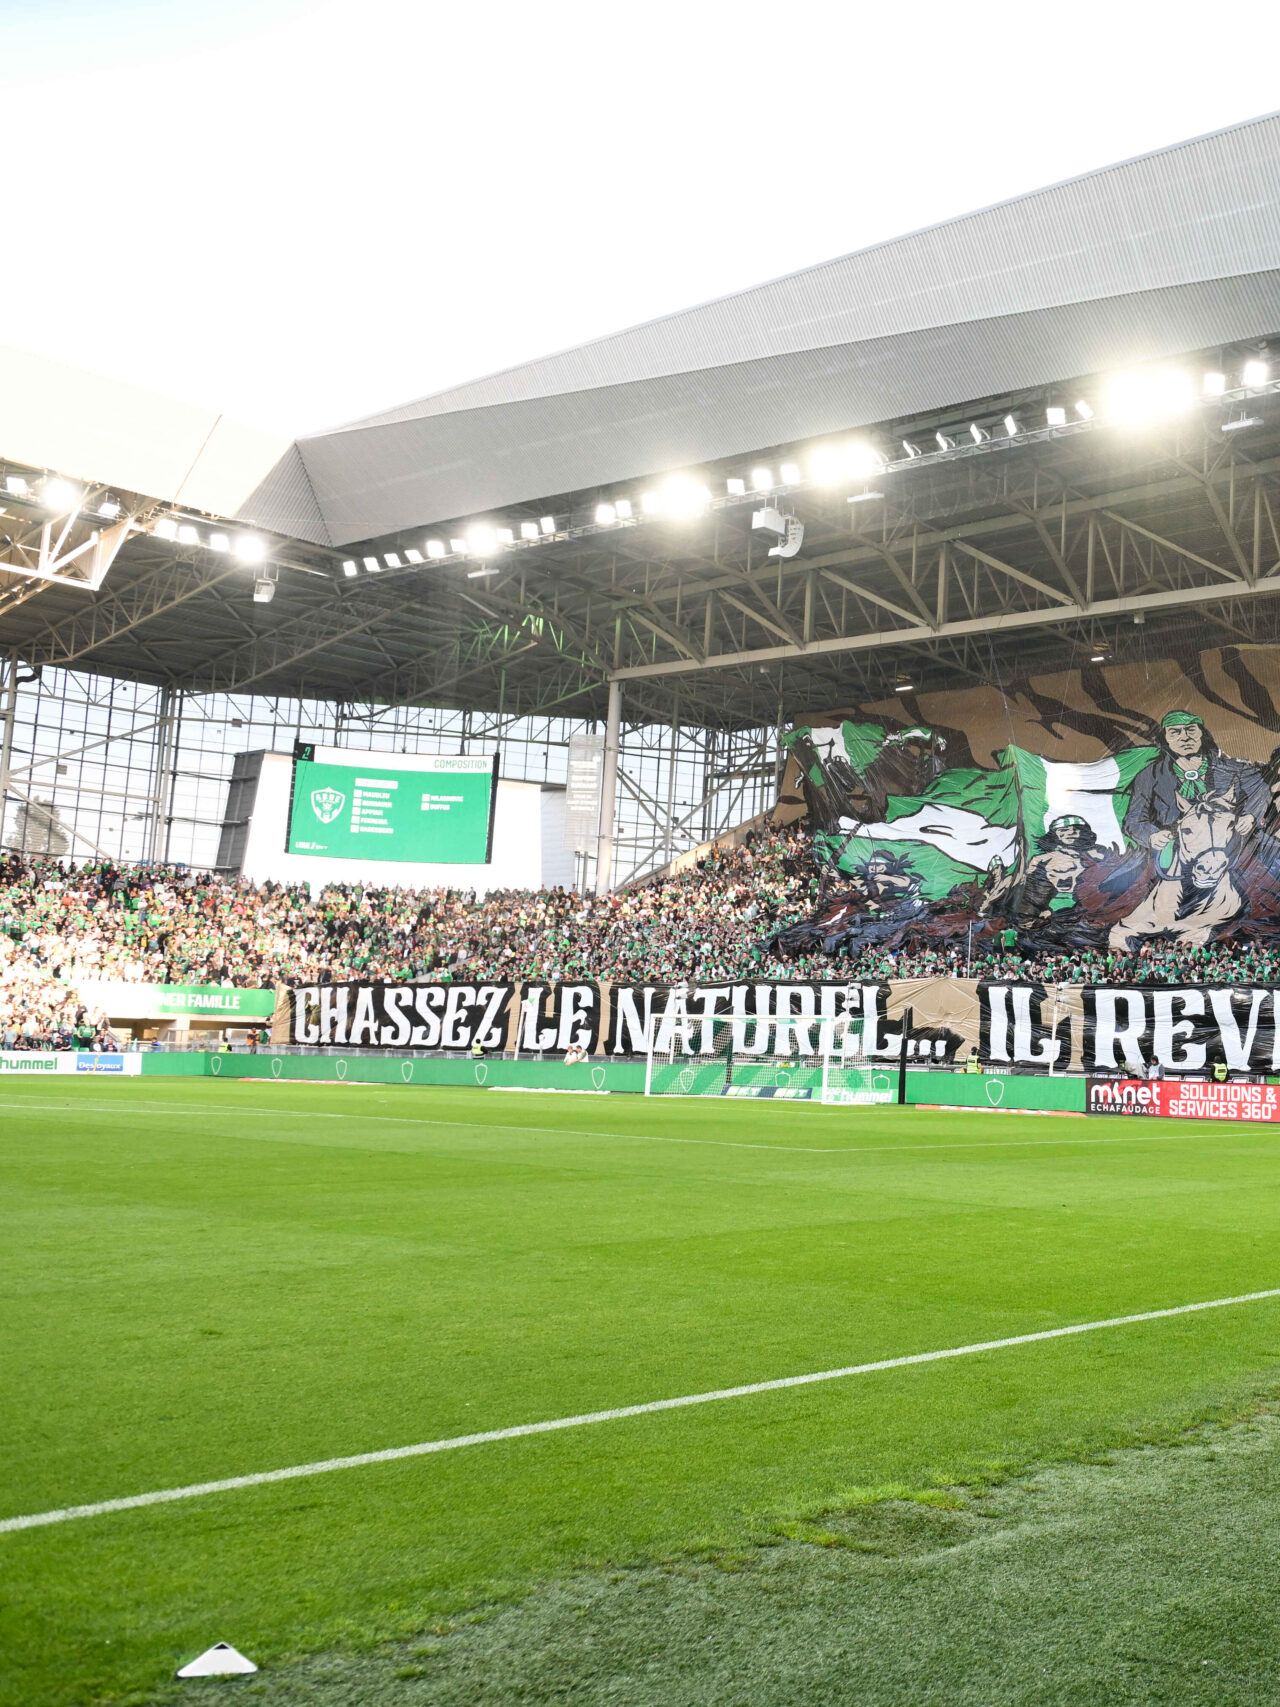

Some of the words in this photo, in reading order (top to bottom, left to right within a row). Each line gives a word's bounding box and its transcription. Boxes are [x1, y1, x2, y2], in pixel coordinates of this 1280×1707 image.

[434, 759, 487, 769] COMPOSITION
[187, 994, 241, 1010] FAMILLE
[293, 986, 508, 1048] CHASSEZ
[522, 986, 593, 1050] LE
[988, 986, 1060, 1063] IL
[0, 1057, 58, 1070] hummel
[1180, 1084, 1262, 1103] SOLUTIONS
[1265, 1087, 1278, 1103] &
[1090, 1103, 1160, 1115] ECHAFAUDAGE
[1169, 1099, 1238, 1119] SERVICES
[1241, 1103, 1278, 1120] 360°
